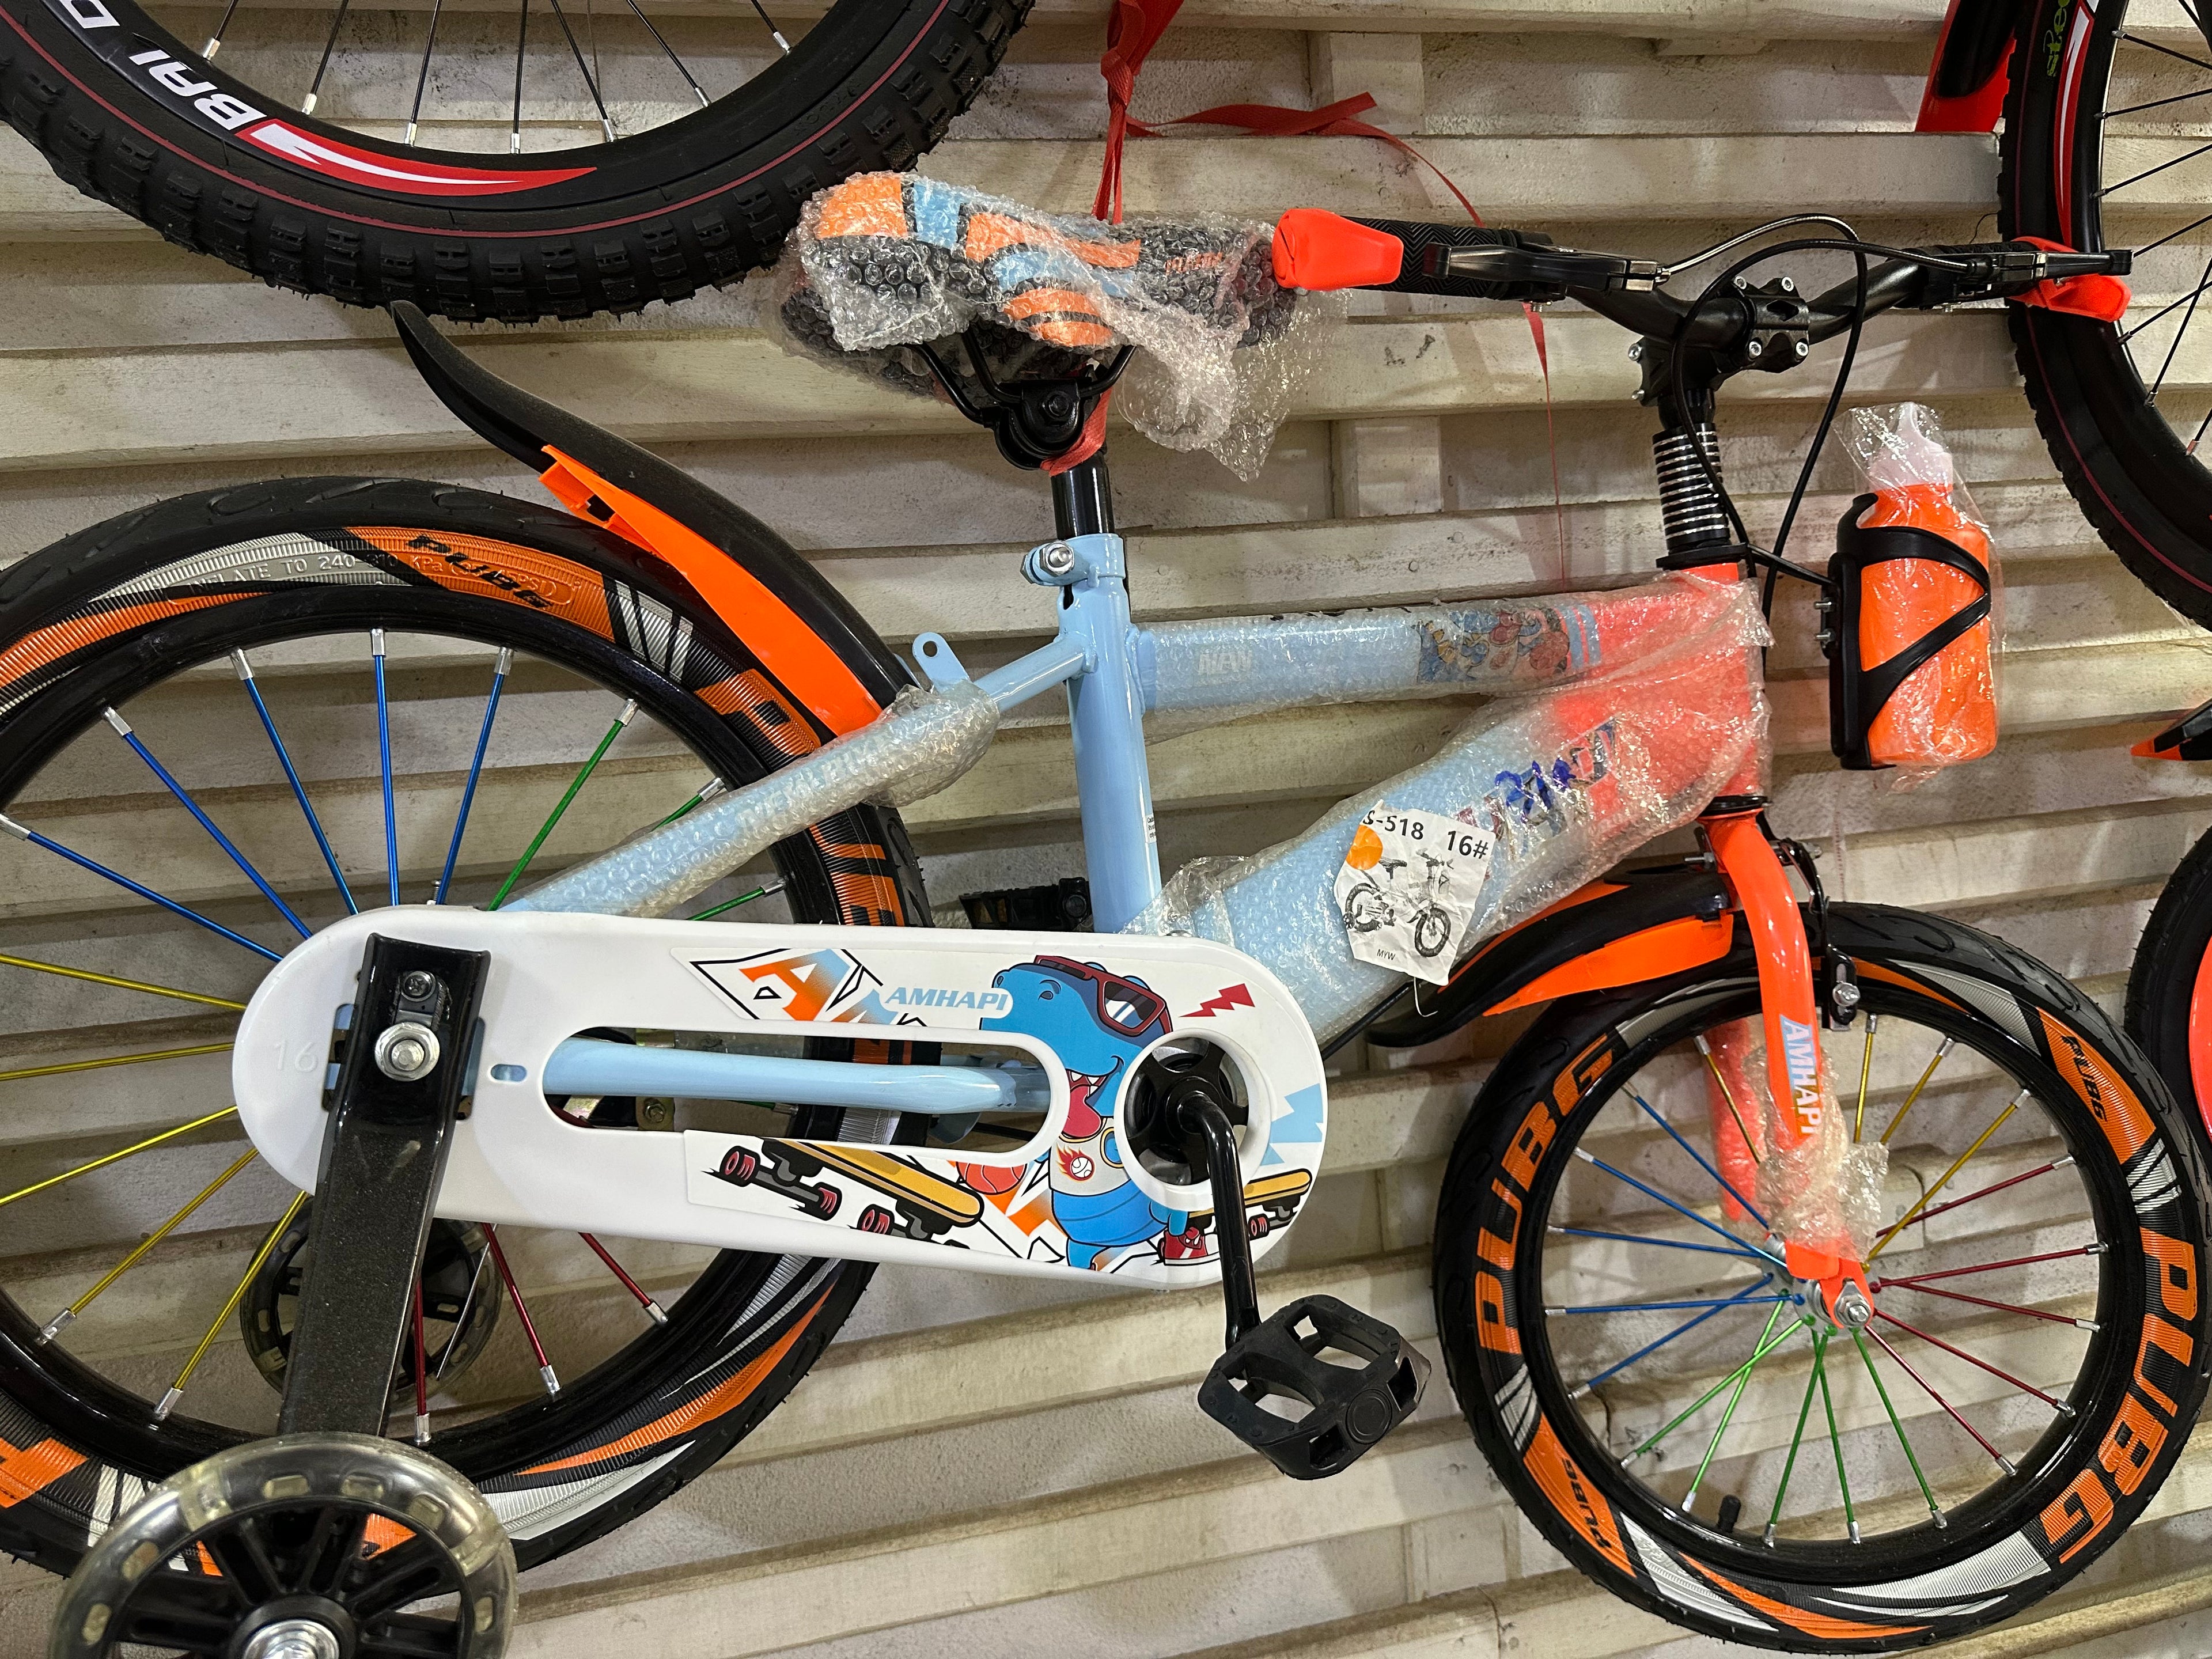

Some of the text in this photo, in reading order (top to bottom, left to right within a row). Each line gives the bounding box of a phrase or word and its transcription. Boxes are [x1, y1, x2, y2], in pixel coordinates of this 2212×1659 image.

[281, 559, 308, 575] TO
[410, 554, 444, 573] KPa
[409, 535, 553, 608] PUBG
[1446, 831, 1488, 859] 16#
[1377, 949, 1396, 960] MYW
[885, 987, 1009, 1010] AMHAPI
[1783, 1020, 1822, 1135] AMHAPI
[2061, 1036, 2108, 1123] PUBG
[1475, 1033, 1613, 1354] PUBG
[2039, 1227, 2197, 1563] PUBG
[1562, 1457, 1612, 1549] PUBG
